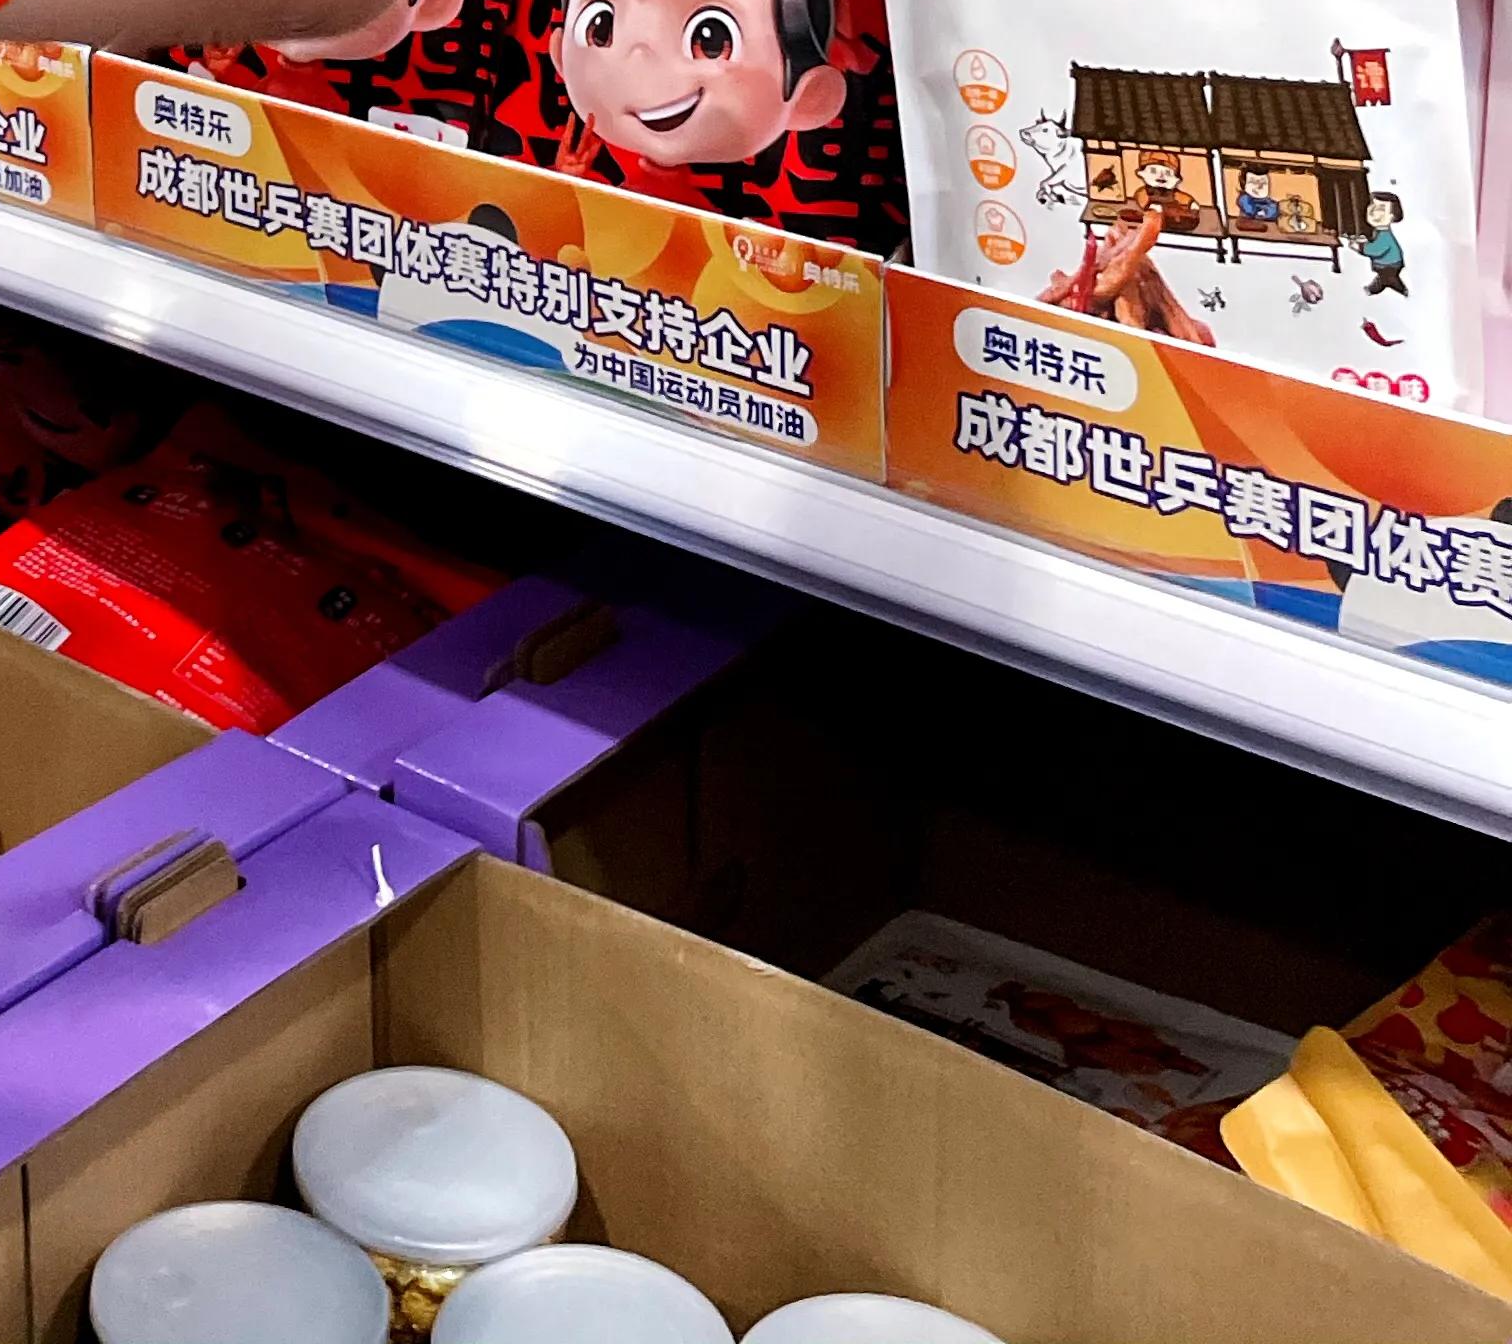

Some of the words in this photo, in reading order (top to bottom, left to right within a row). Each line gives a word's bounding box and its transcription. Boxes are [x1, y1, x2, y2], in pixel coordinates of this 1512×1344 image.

[153, 94, 232, 145] 奥特乐
[136, 147, 813, 398] 成都世乒赛团体赛特别支持企业
[573, 341, 804, 440] 为中国运动员加油
[982, 324, 1106, 395] 奥特乐
